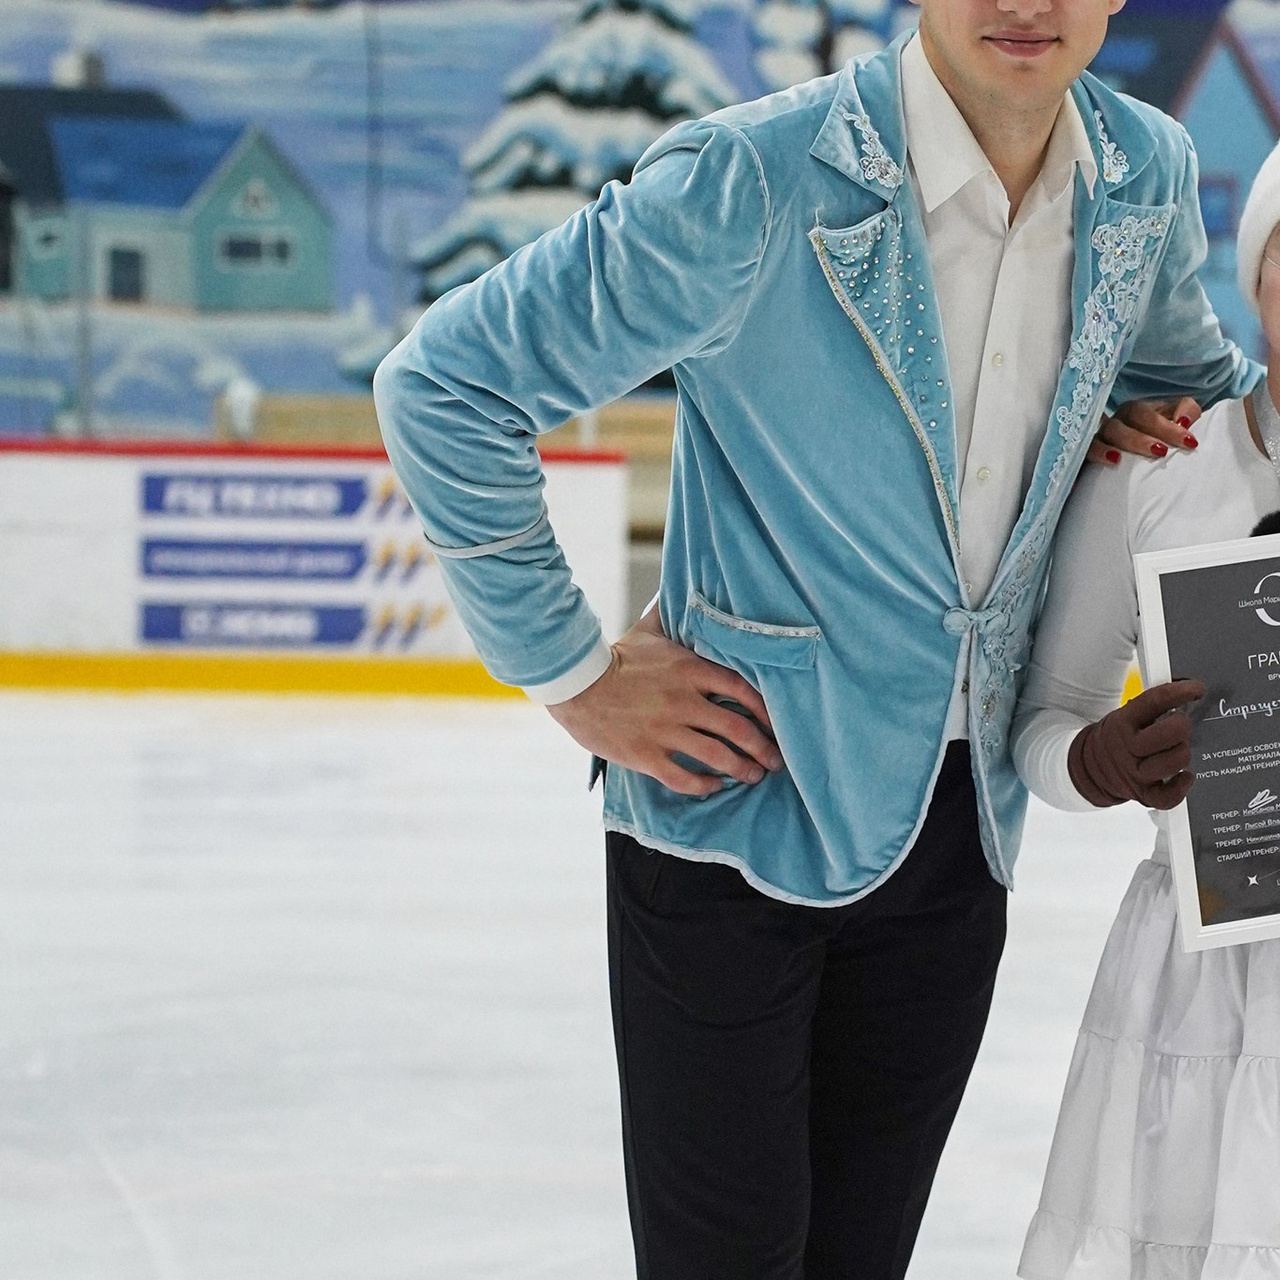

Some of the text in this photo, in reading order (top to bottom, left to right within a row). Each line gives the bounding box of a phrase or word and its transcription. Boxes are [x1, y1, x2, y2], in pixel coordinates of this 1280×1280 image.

[1238, 597, 1263, 609] Школа
[1201, 753, 1211, 761] ЗА
[1212, 746, 1253, 759] УСПЕШНОЕ
[1238, 751, 1280, 764] МАТЕРИАЛА
[1196, 770, 1219, 780] ПУСТЬ
[1220, 764, 1252, 776] КАЖДАЯ
[1212, 810, 1241, 820] ТРЕНЕР:
[1213, 824, 1242, 834] ТРЕНЕР:
[1215, 838, 1244, 849] ТРЕНЕР:
[1217, 846, 1280, 862] СТАРШИЙ ТРЕНЕР:
